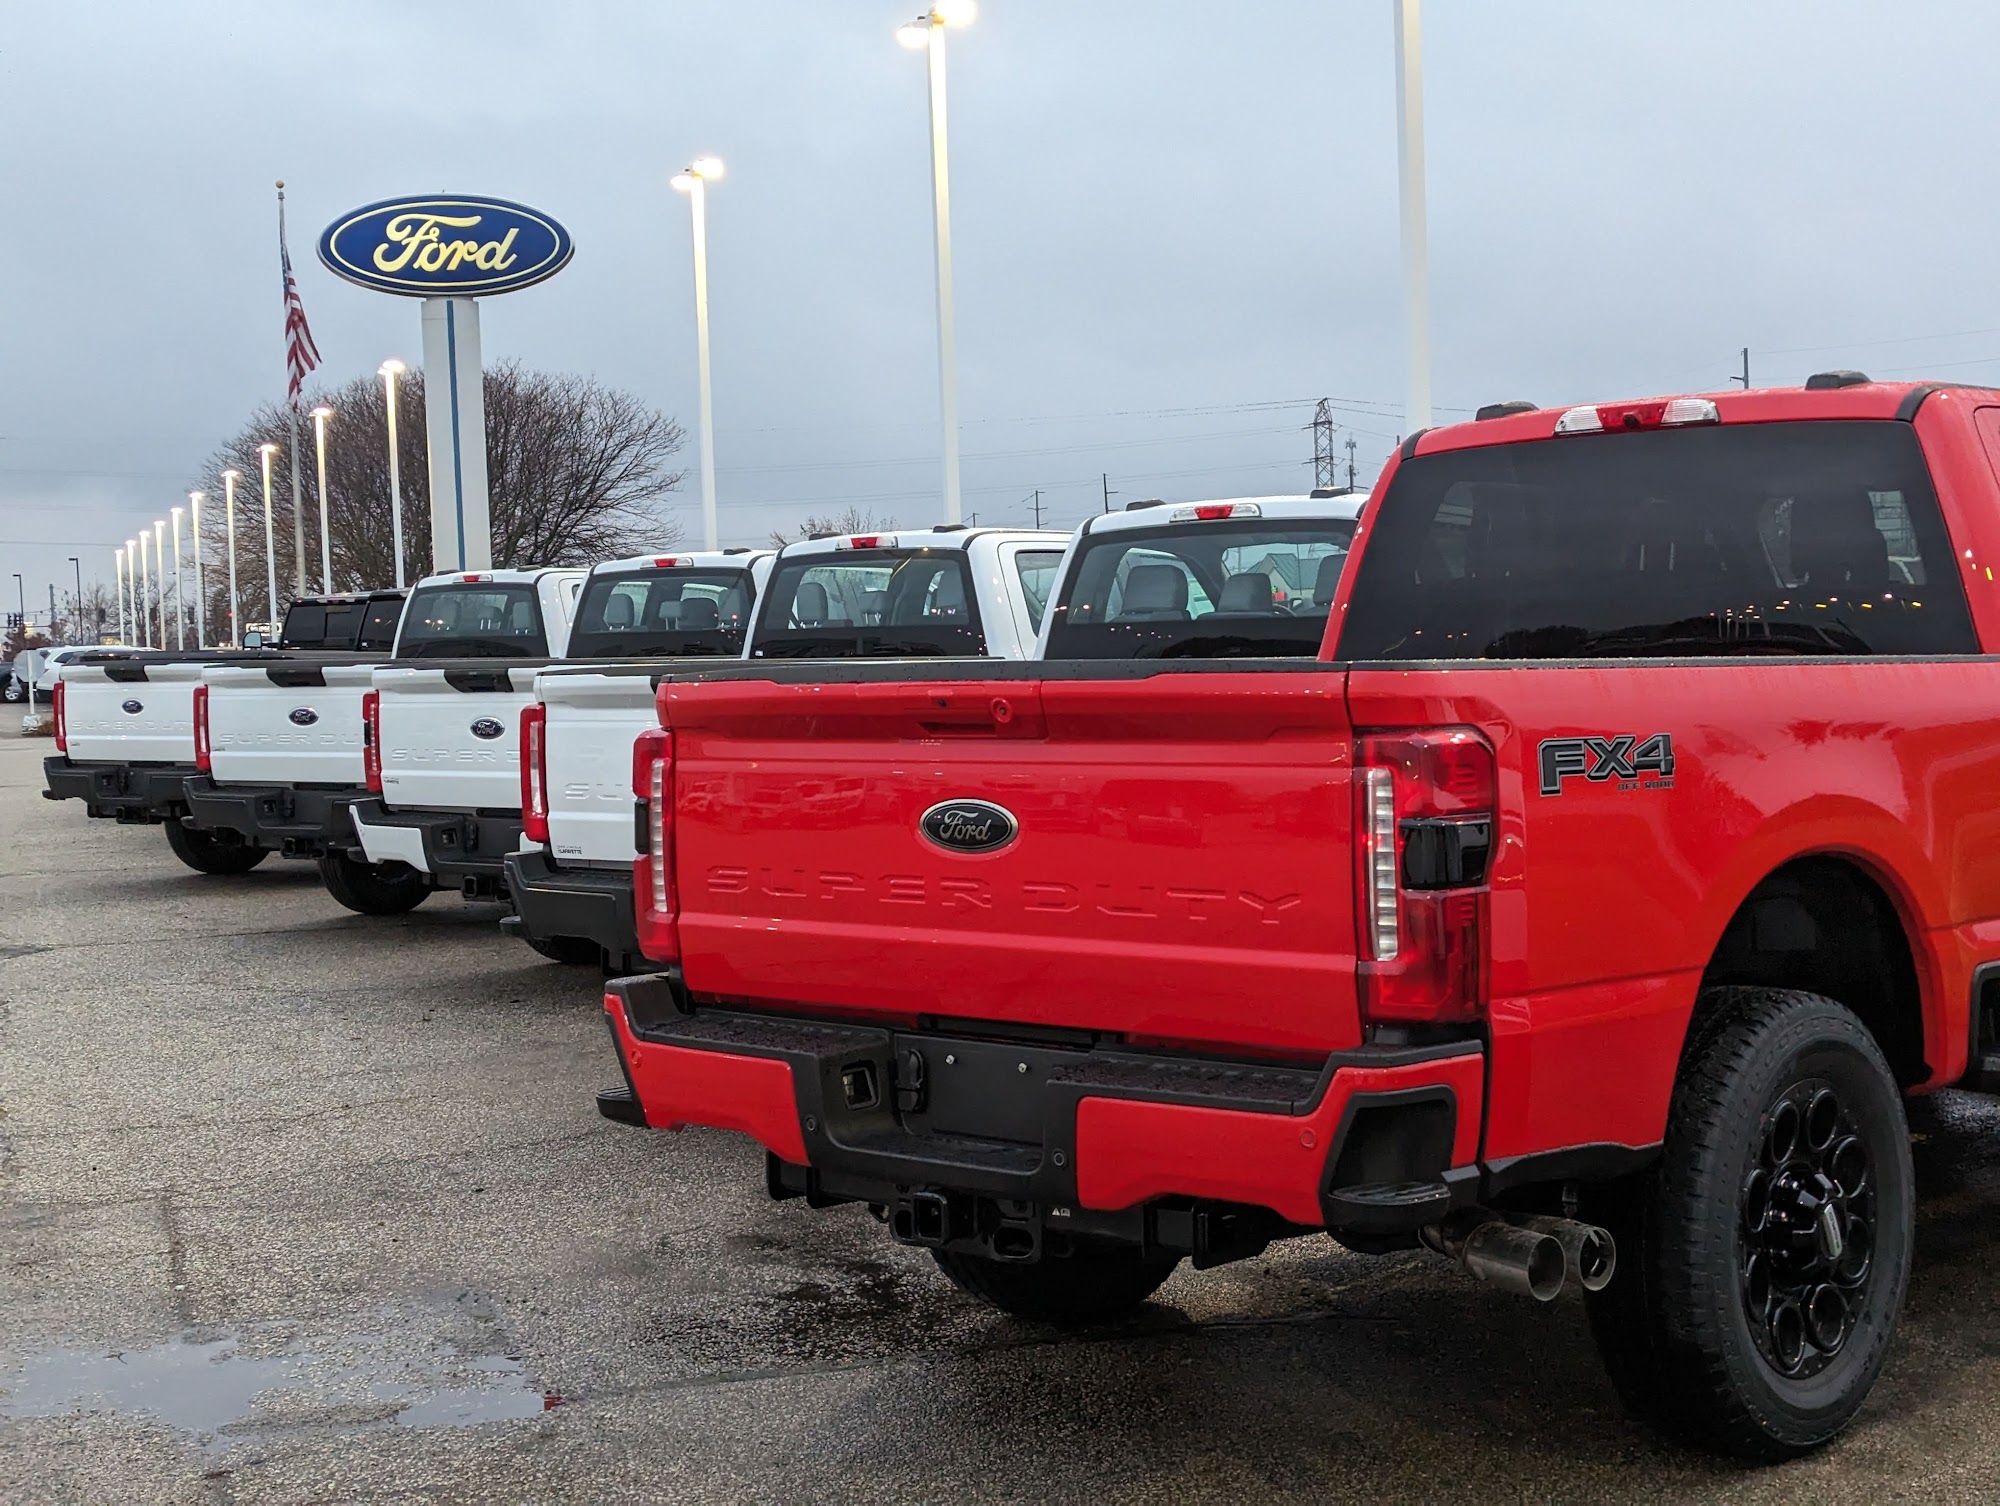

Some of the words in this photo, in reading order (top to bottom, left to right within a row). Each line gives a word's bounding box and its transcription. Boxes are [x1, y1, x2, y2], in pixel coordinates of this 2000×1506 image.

[373, 213, 520, 272] Ford
[144, 720, 193, 731] DUT
[476, 721, 496, 735] Ford
[219, 733, 312, 745] SUPER
[391, 748, 497, 762] SUPER
[1537, 733, 1675, 797] FX4
[1617, 781, 1640, 791] OFF
[940, 810, 991, 840] Ford
[706, 865, 993, 908] SUPER
[1023, 880, 1301, 924] DUTY
